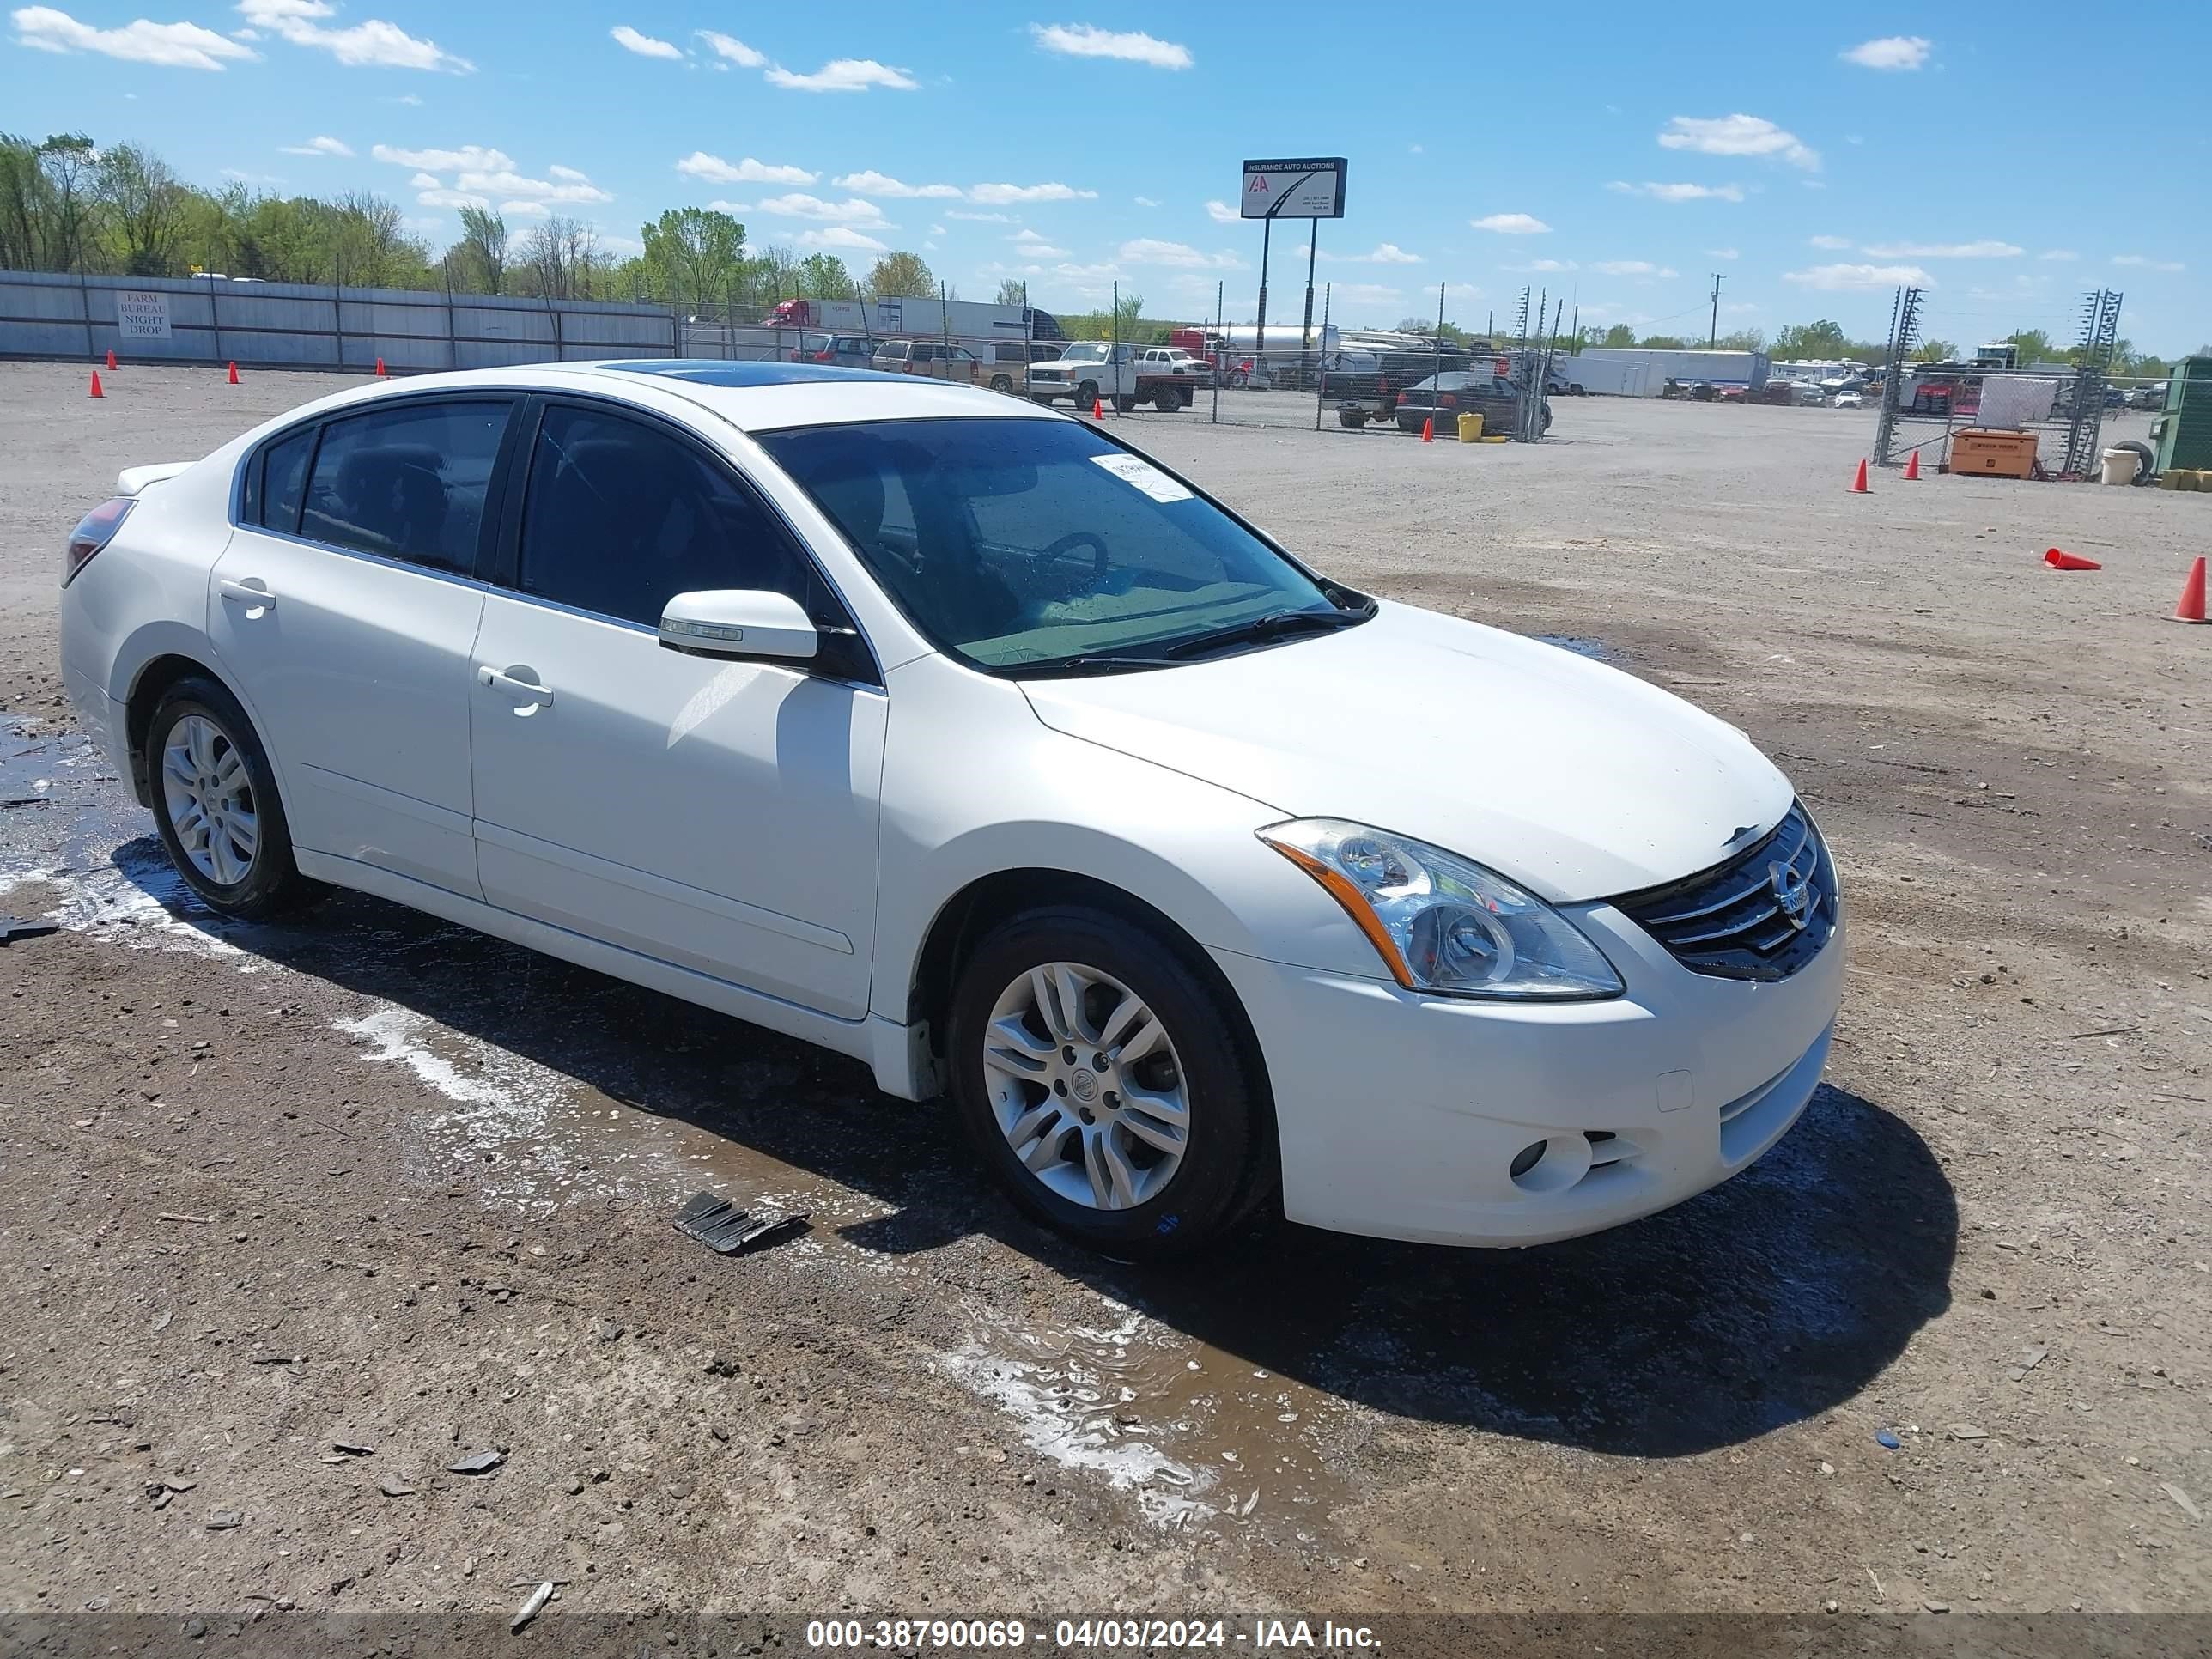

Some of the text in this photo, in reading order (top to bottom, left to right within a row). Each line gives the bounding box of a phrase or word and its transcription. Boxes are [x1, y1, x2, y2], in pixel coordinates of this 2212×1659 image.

[127, 295, 157, 303] FARM
[121, 304, 165, 313] BUREAU
[125, 315, 164, 325] NIGHT
[130, 325, 161, 334] DROP
